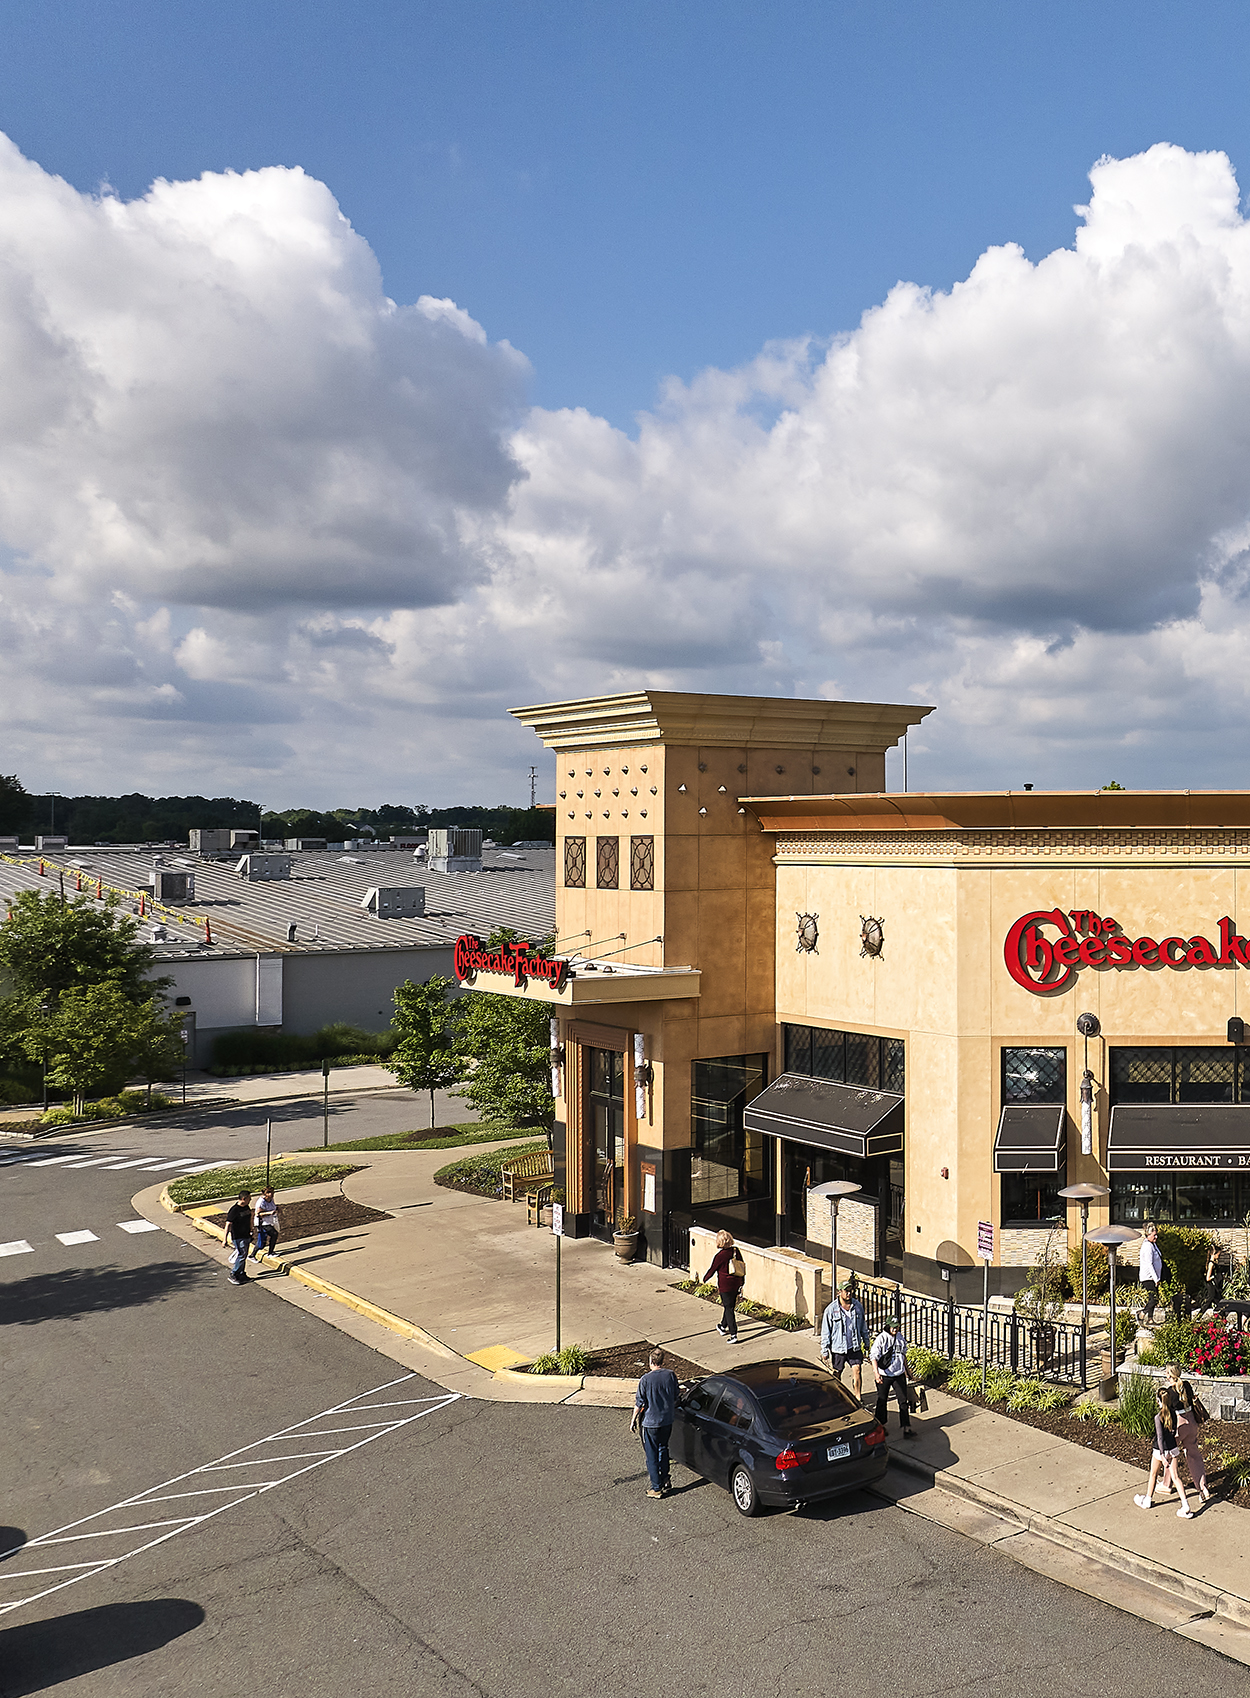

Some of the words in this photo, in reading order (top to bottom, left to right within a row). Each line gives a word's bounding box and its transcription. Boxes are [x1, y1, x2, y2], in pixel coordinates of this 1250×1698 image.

[1069, 910, 1118, 937] The
[454, 935, 514, 981] Cheesecake
[508, 942, 563, 989] Factory
[1145, 1155, 1221, 1166] RESTAURANT
